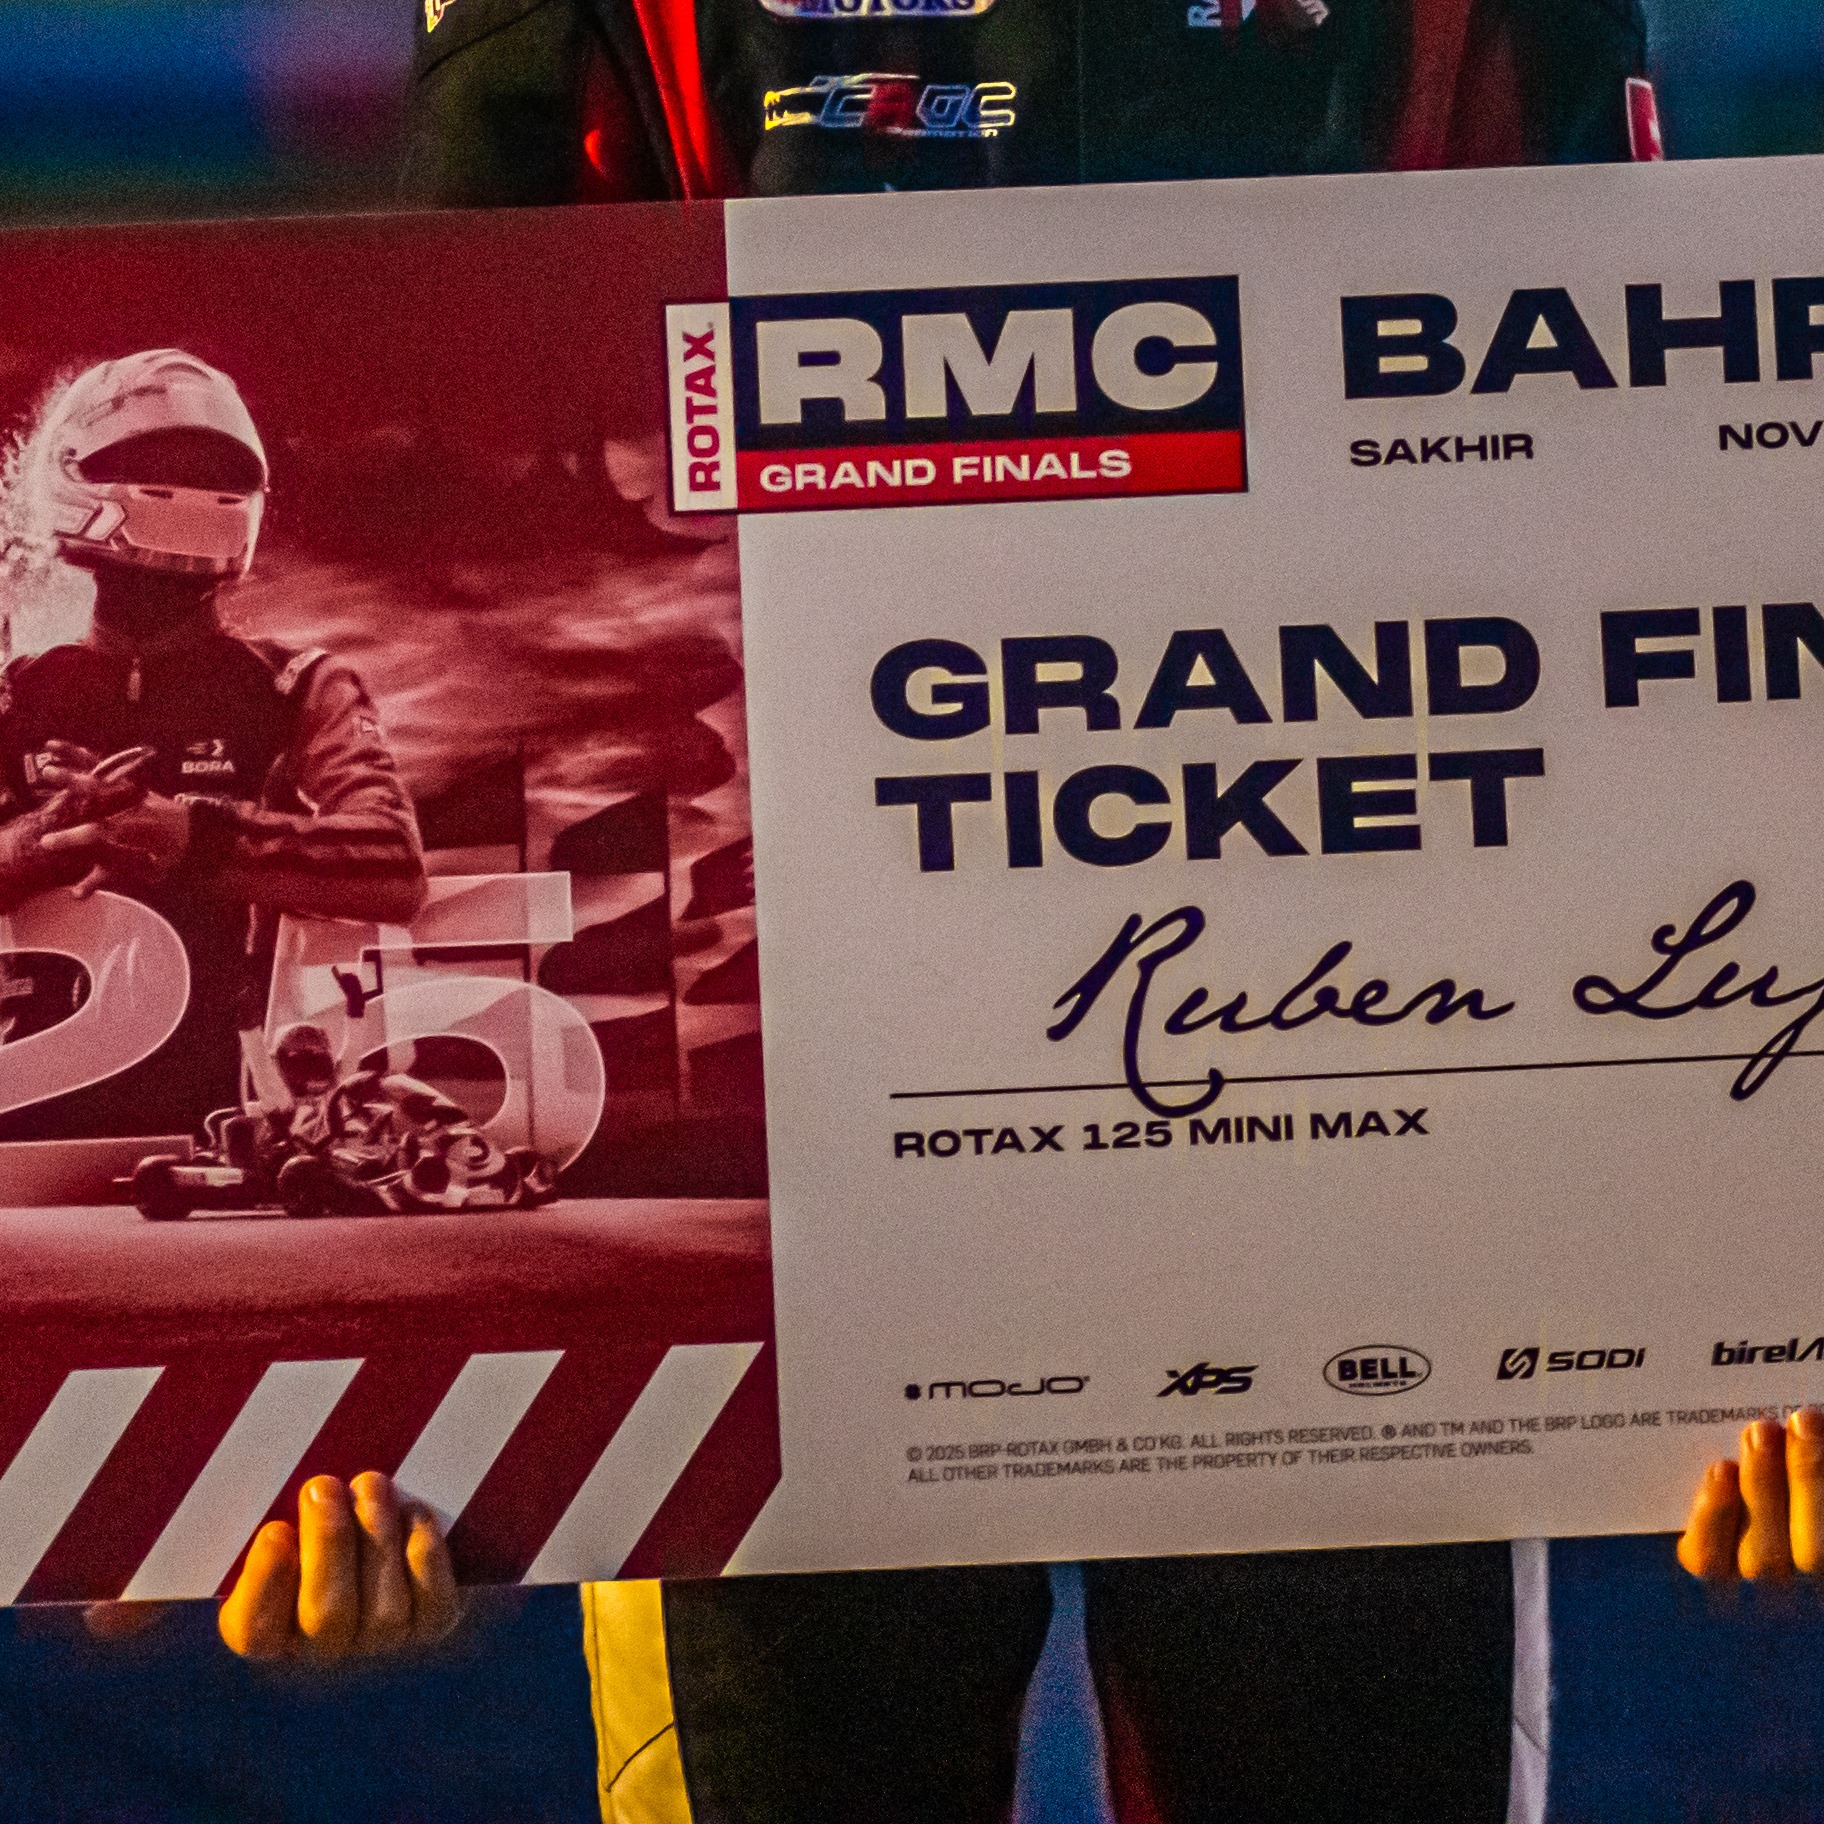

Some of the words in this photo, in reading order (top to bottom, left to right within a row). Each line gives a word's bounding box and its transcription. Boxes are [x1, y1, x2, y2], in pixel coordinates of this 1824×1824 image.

[755, 301, 1219, 425] RMC
[683, 330, 721, 492] ROTAX
[1349, 433, 1534, 467] SAKHIR
[1718, 420, 1824, 451] NOV
[759, 459, 937, 493] GRAND
[952, 449, 1132, 484] FINALS
[870, 616, 1541, 741] GRAND
[874, 747, 1546, 873] TICKET
[1046, 905, 1516, 1119] Ruben
[893, 1124, 1065, 1159] ROTAX
[1083, 1118, 1175, 1151] 125
[1187, 1112, 1294, 1146] MINI
[1310, 1108, 1429, 1140] MAX
[1157, 1361, 1258, 1398] XPS
[1338, 1357, 1417, 1381] BELL
[1546, 1347, 1646, 1372] SODI
[926, 1444, 965, 1461] 2025
[1062, 1438, 1112, 1456] GMBH
[1116, 1437, 1129, 1453] &
[1191, 1433, 1218, 1449] ALL
[1225, 1428, 1284, 1447] RIGHTS
[1401, 1423, 1435, 1439] AND
[1439, 1421, 1465, 1436] TM
[1469, 1418, 1504, 1435] AND
[1508, 1416, 1542, 1433] THE
[1544, 1415, 1576, 1432] BRP
[1581, 1412, 1626, 1430] LOGO
[1629, 1411, 1662, 1428] ARE
[1666, 1405, 1778, 1426] TRADEMARKS
[908, 1467, 940, 1483] ALL
[942, 1463, 998, 1482] OTHER
[1003, 1458, 1116, 1478] TRADEMARKS
[1119, 1456, 1151, 1474] ARE
[1157, 1454, 1187, 1472] THE
[1193, 1450, 1277, 1470] PROPERTY
[1281, 1448, 1303, 1466] OF
[1308, 1446, 1356, 1465] THEIR
[1359, 1441, 1455, 1462] RESPECTIVE
